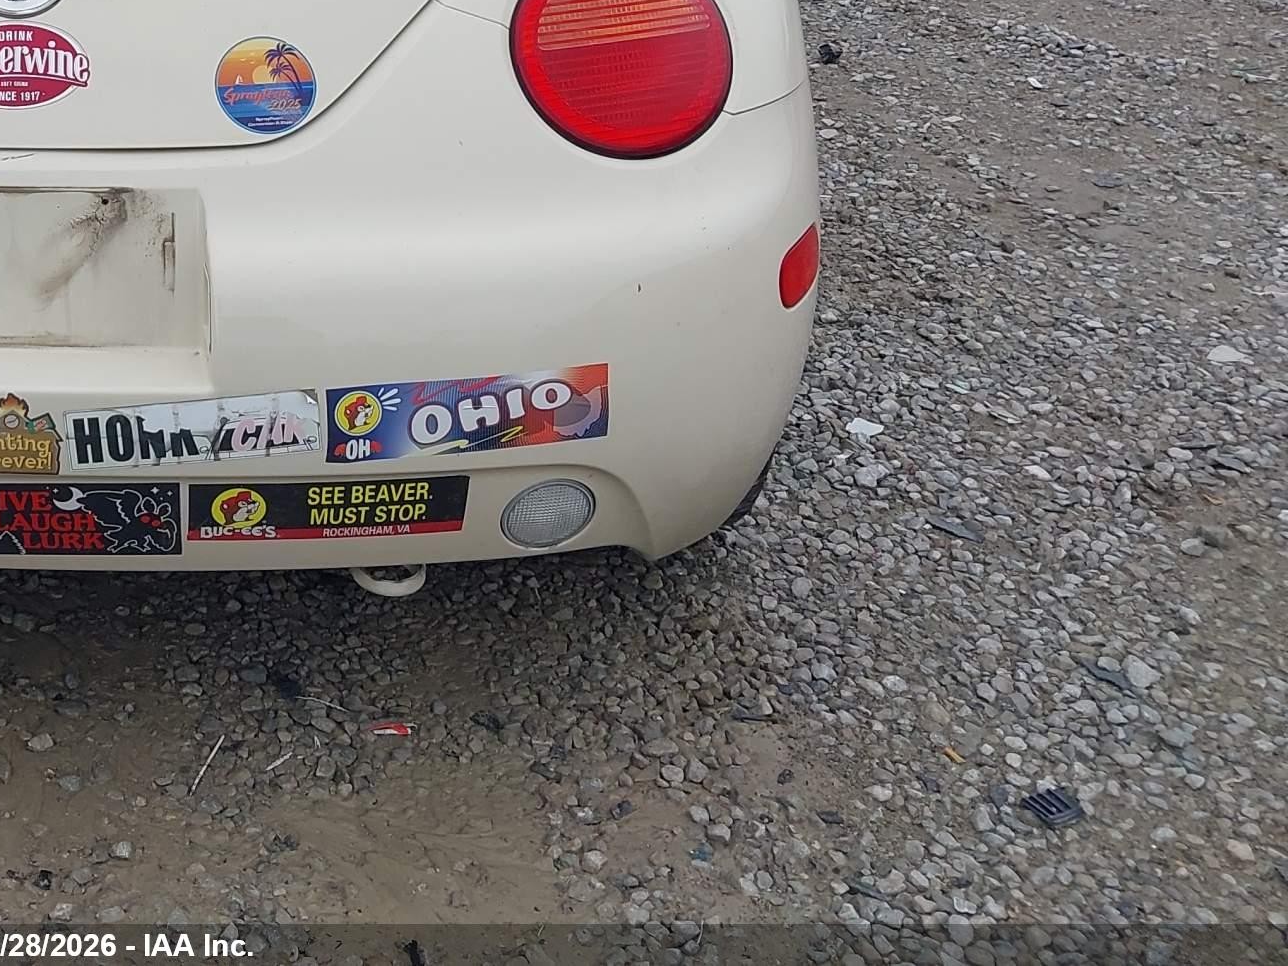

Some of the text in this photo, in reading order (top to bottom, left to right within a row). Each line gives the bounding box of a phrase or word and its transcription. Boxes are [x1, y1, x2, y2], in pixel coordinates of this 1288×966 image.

[20, 91, 40, 101] 1917
[270, 98, 302, 110] 2025
[410, 381, 572, 445] OHIO
[345, 439, 371, 460] OH
[307, 481, 433, 506] SEE BEAVER.
[310, 503, 427, 526] MUST STOP.
[323, 524, 410, 538] ROCKINGHAM, VA
[23, 532, 104, 550] LURK
